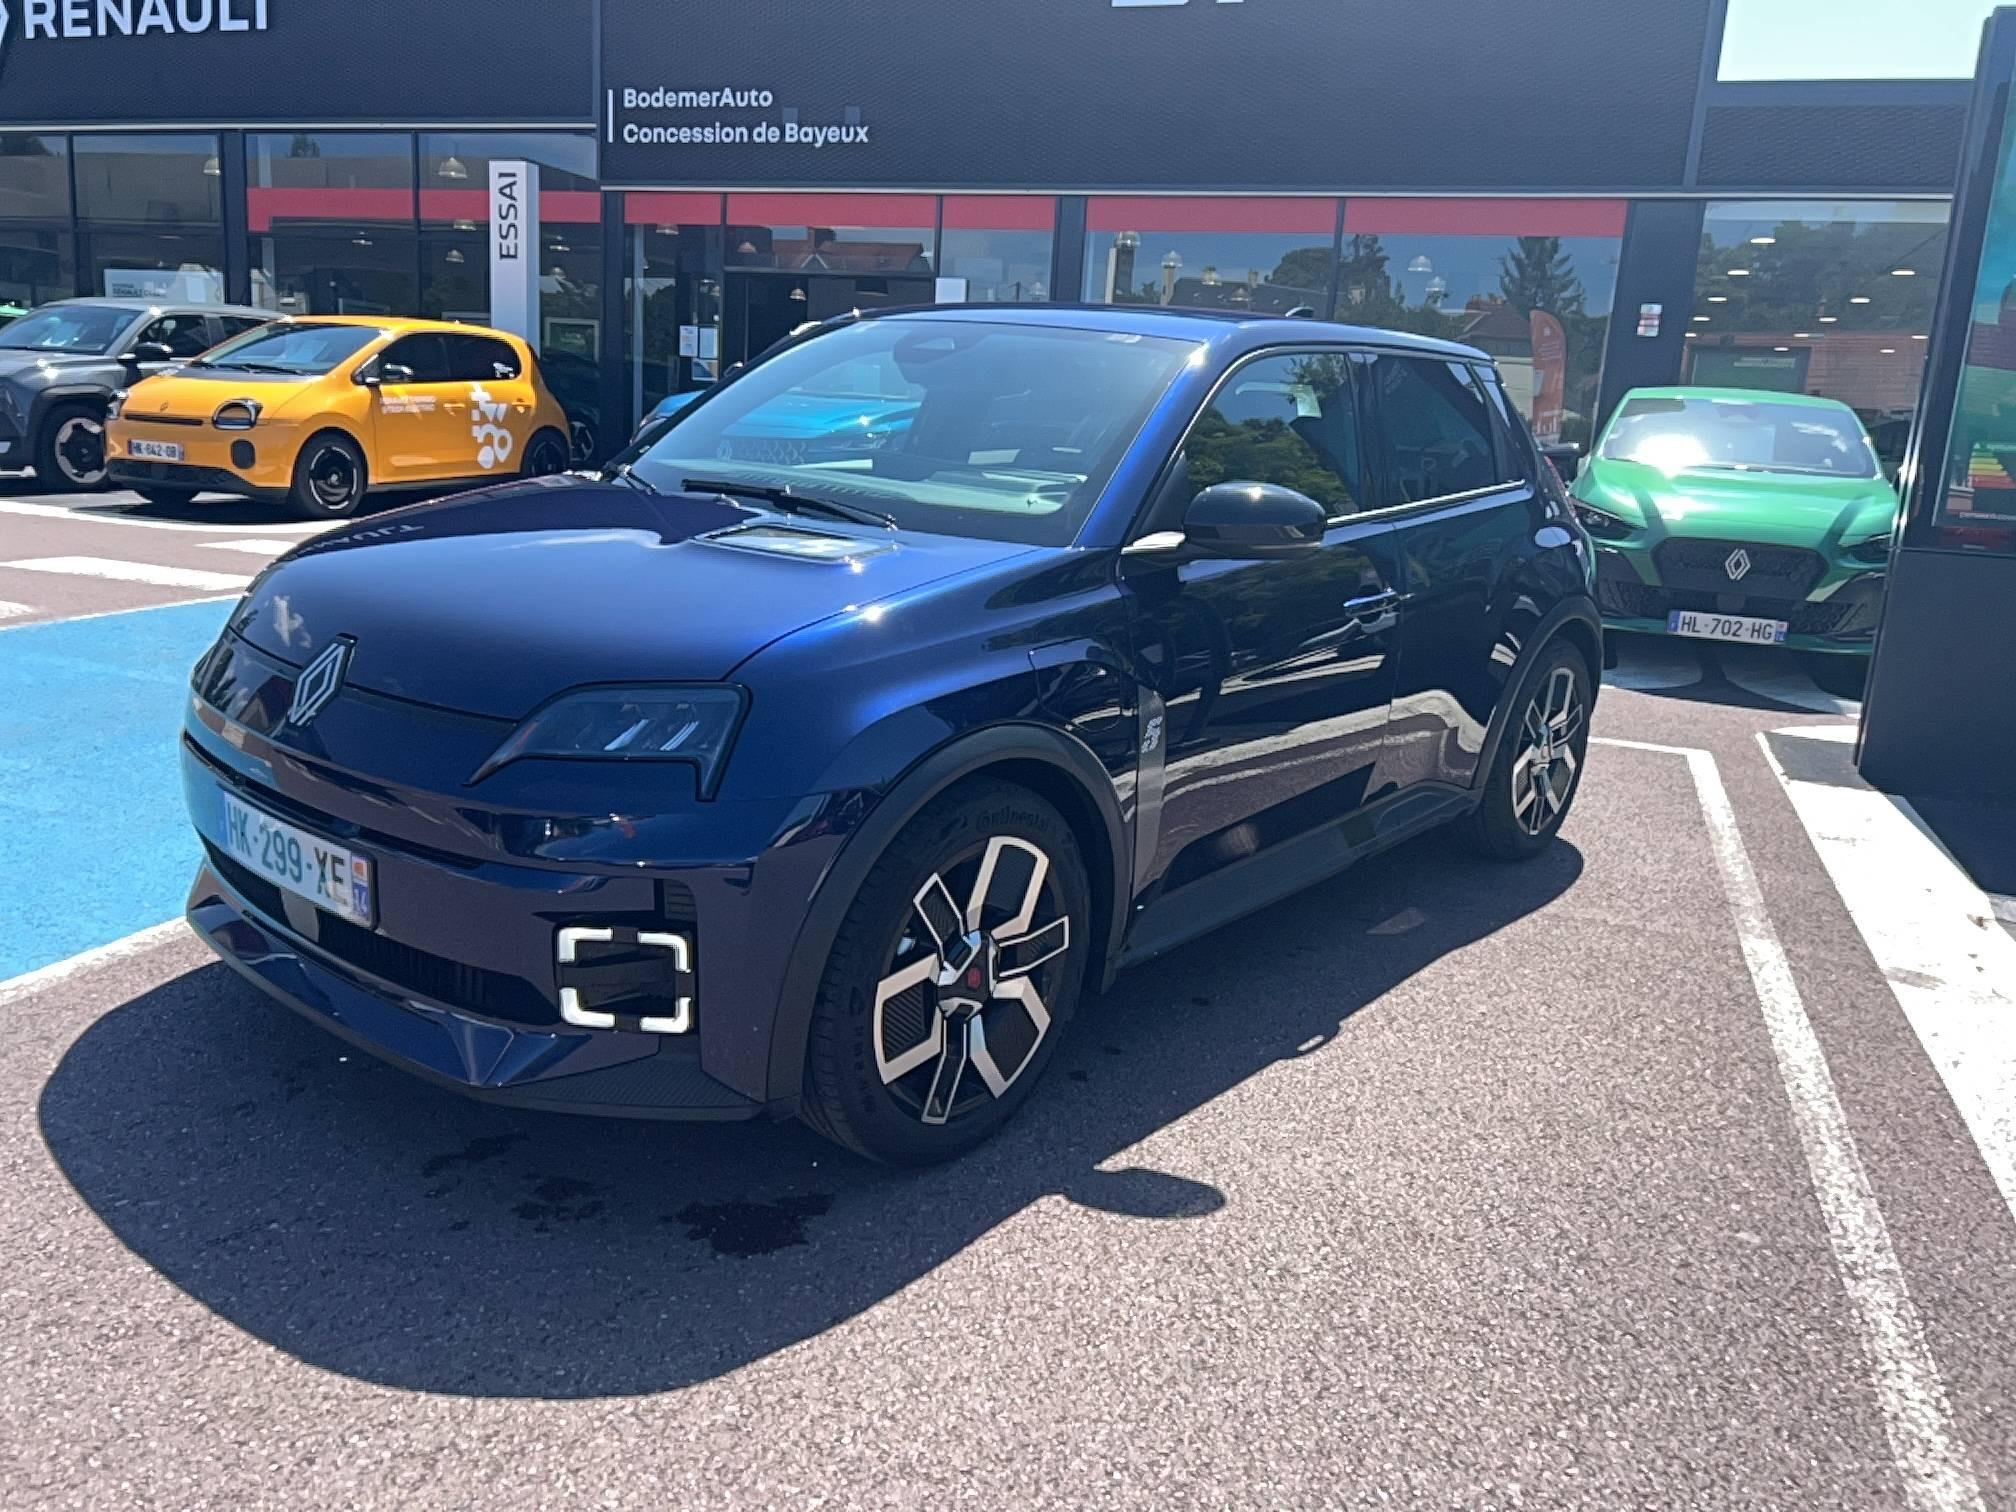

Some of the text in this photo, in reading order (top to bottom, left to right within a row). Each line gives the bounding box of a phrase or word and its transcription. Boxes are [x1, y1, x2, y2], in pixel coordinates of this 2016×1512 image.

[24, 0, 268, 39] RENAULT
[622, 86, 774, 109] BodemerAuto
[622, 121, 870, 148] Concession de Bayeux
[498, 172, 518, 260] ESSAI
[1680, 615, 1774, 641] HL-702-HG
